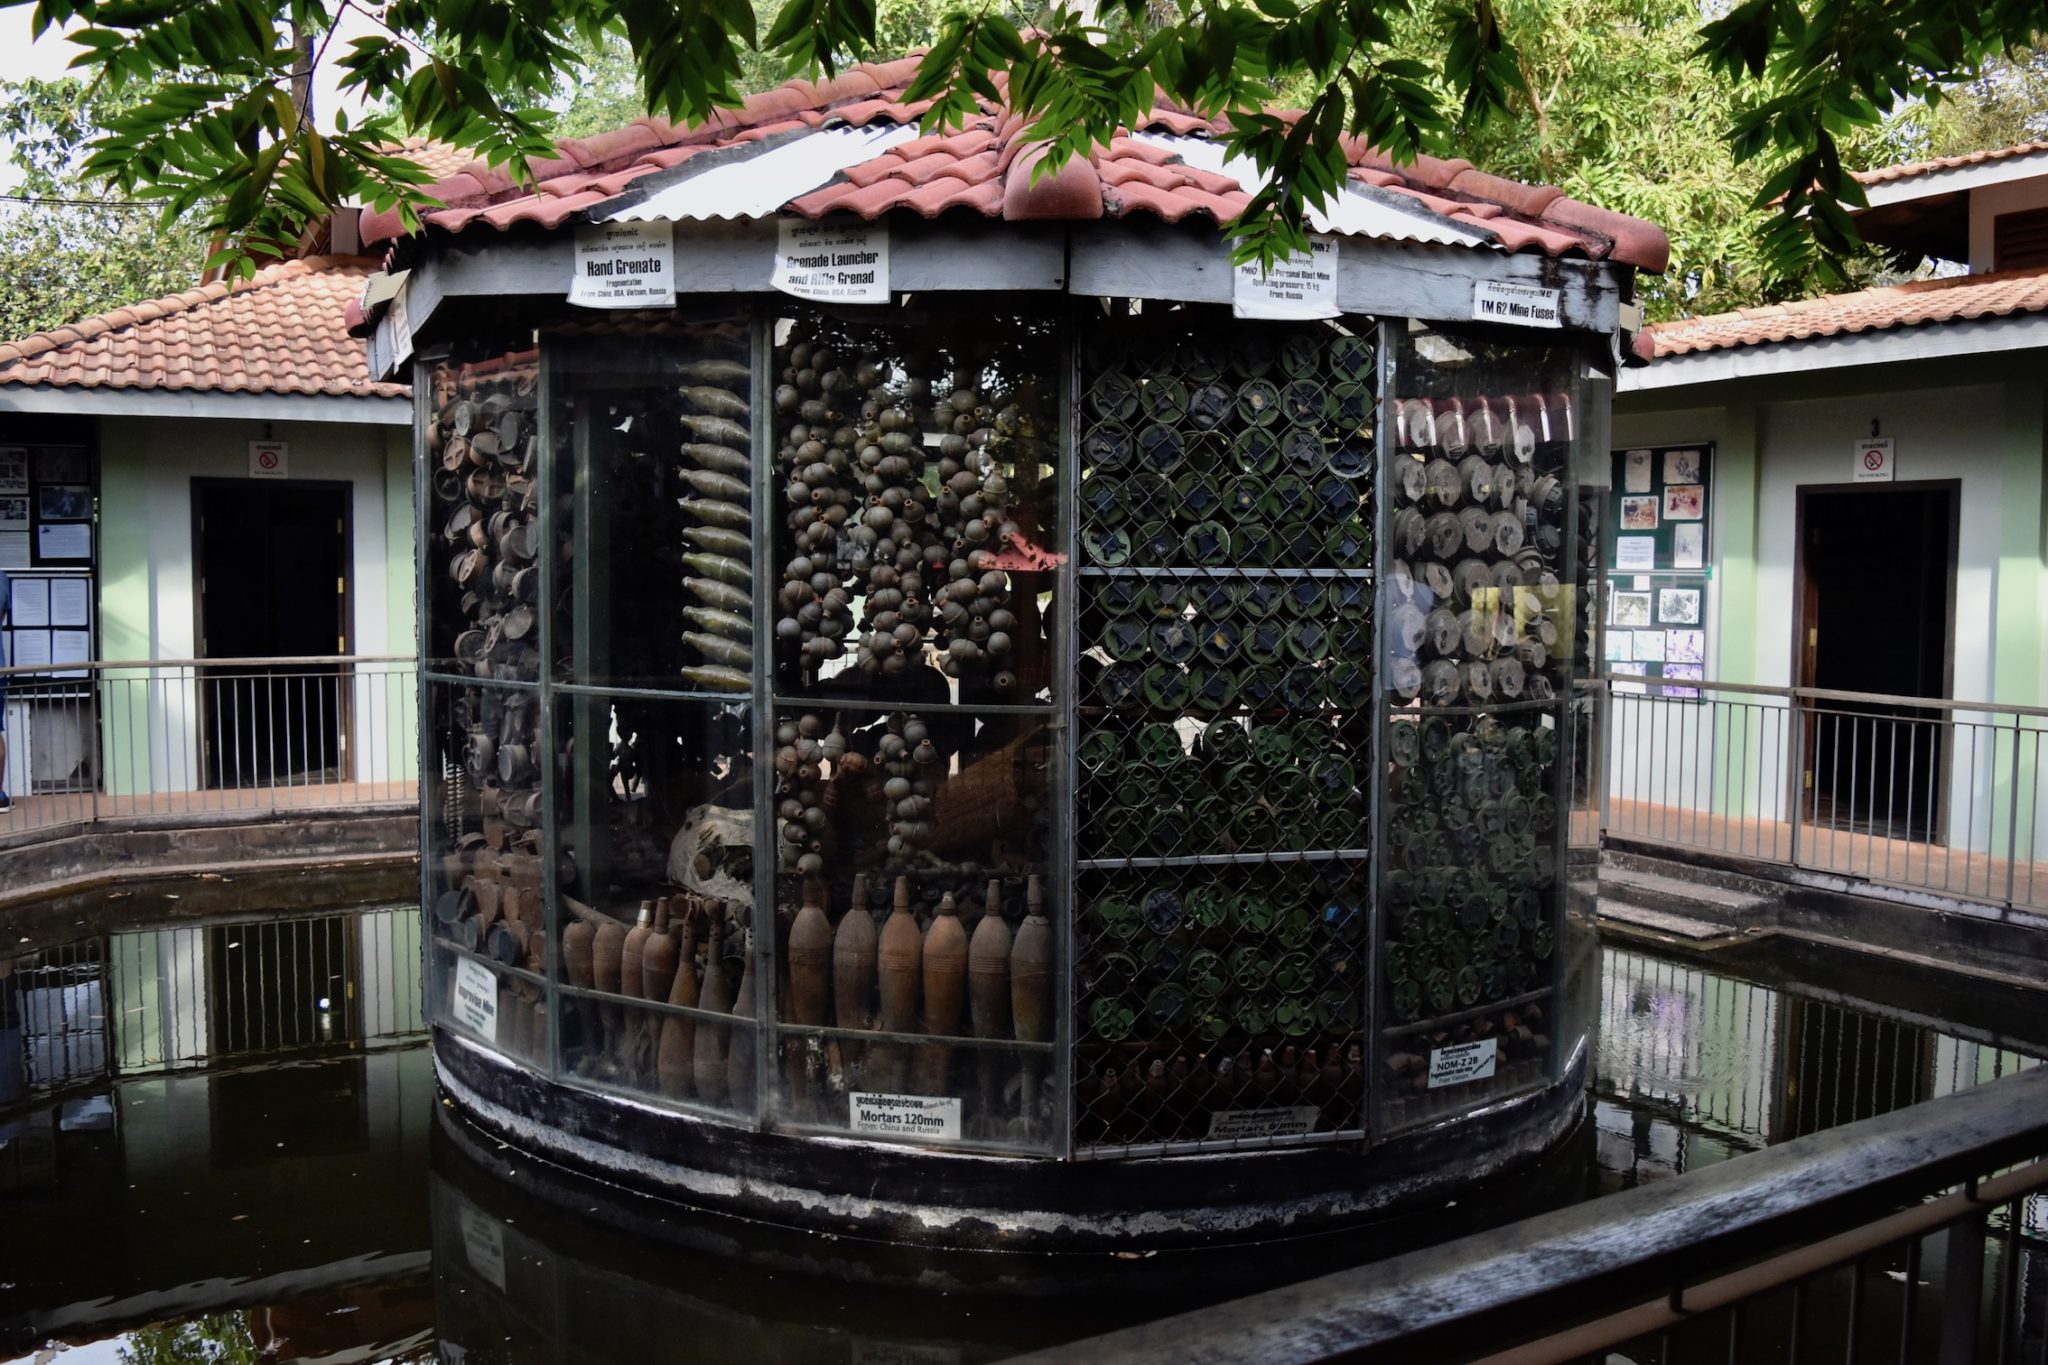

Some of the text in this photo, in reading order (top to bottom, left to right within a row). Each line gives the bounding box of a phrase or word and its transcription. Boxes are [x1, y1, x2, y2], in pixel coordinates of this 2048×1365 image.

[1325, 243, 1330, 253] 2
[587, 257, 661, 277] Hand Grenate
[787, 251, 879, 269] Grenade Launcher
[788, 274, 808, 285] and
[838, 270, 875, 285] Grenad
[1301, 270, 1316, 280] Blast
[1317, 272, 1330, 280] Mine
[1286, 291, 1303, 300] Russia
[1481, 300, 1555, 320] TM 62 Mine Fuses
[1871, 419, 1879, 437] 3
[861, 1110, 944, 1126] Mortars 120mm
[880, 1123, 900, 1132] China
[902, 1125, 915, 1133] and
[917, 1126, 940, 1134] Russia
